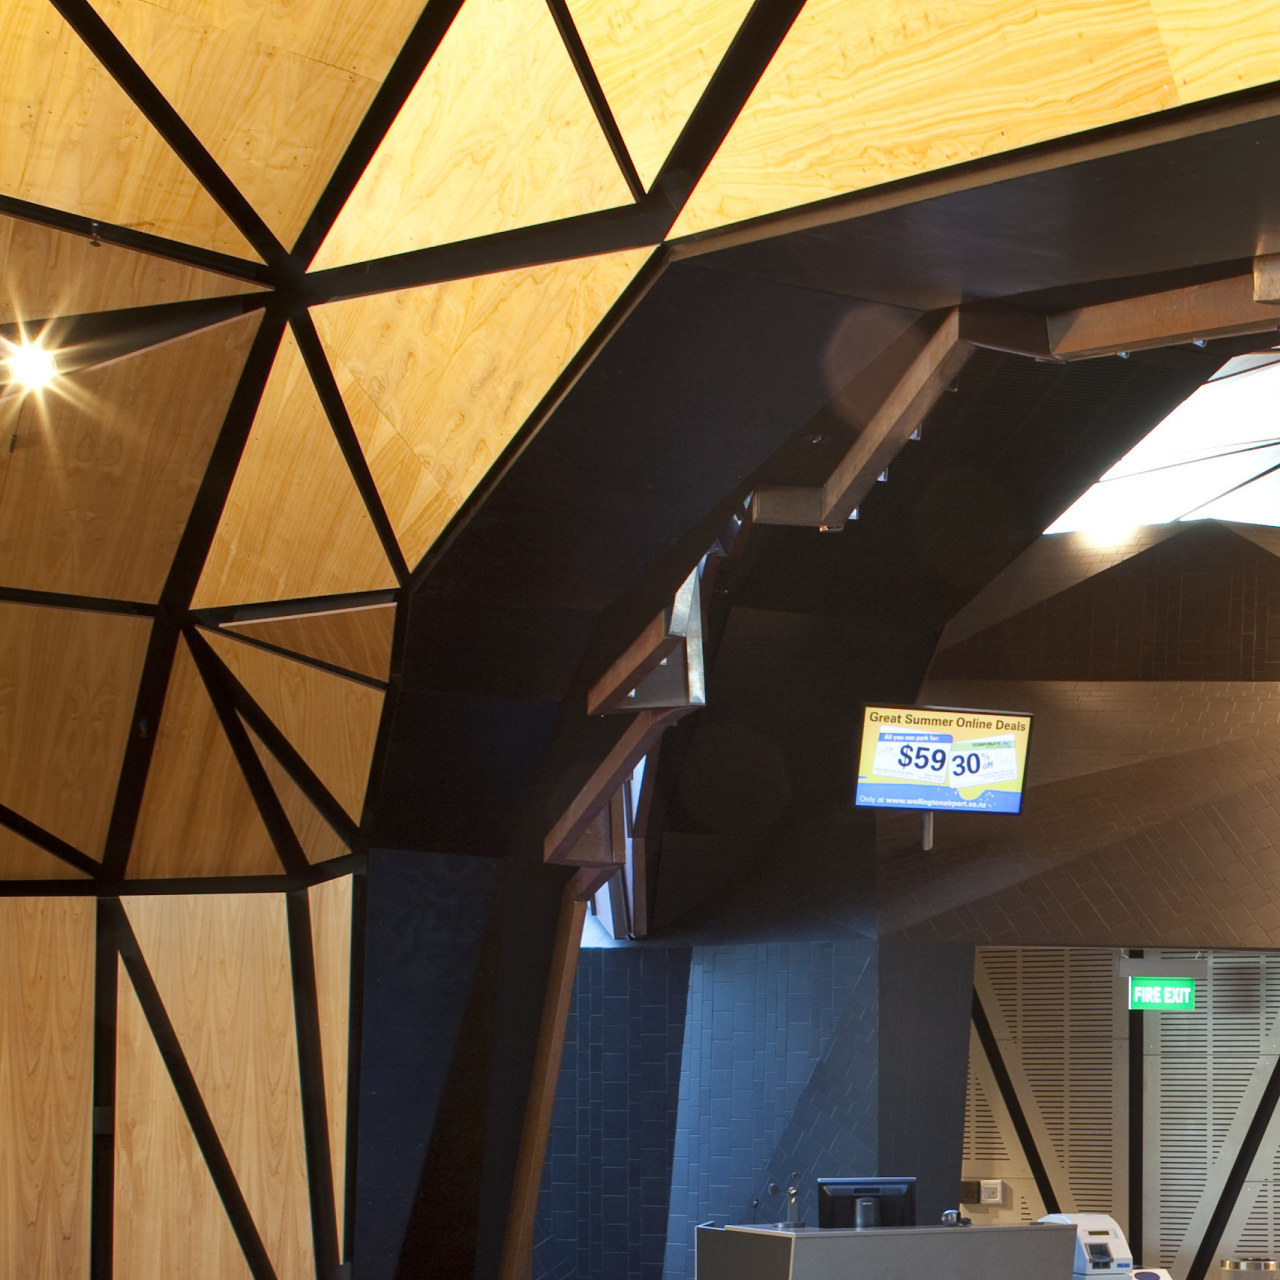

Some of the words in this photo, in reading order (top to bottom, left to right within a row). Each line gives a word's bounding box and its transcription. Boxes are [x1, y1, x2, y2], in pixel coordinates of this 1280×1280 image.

[869, 711, 902, 724] Great
[904, 714, 953, 728] Summer
[956, 716, 992, 729] Online
[995, 719, 1026, 732] Deals
[898, 743, 946, 771] $59
[952, 753, 981, 776] 30
[982, 761, 993, 769] off
[859, 795, 876, 805] Only
[885, 798, 987, 809] www.wellingtonairport.co.nz
[1134, 986, 1162, 1003] FIRE
[1163, 987, 1191, 1004] EXIT
